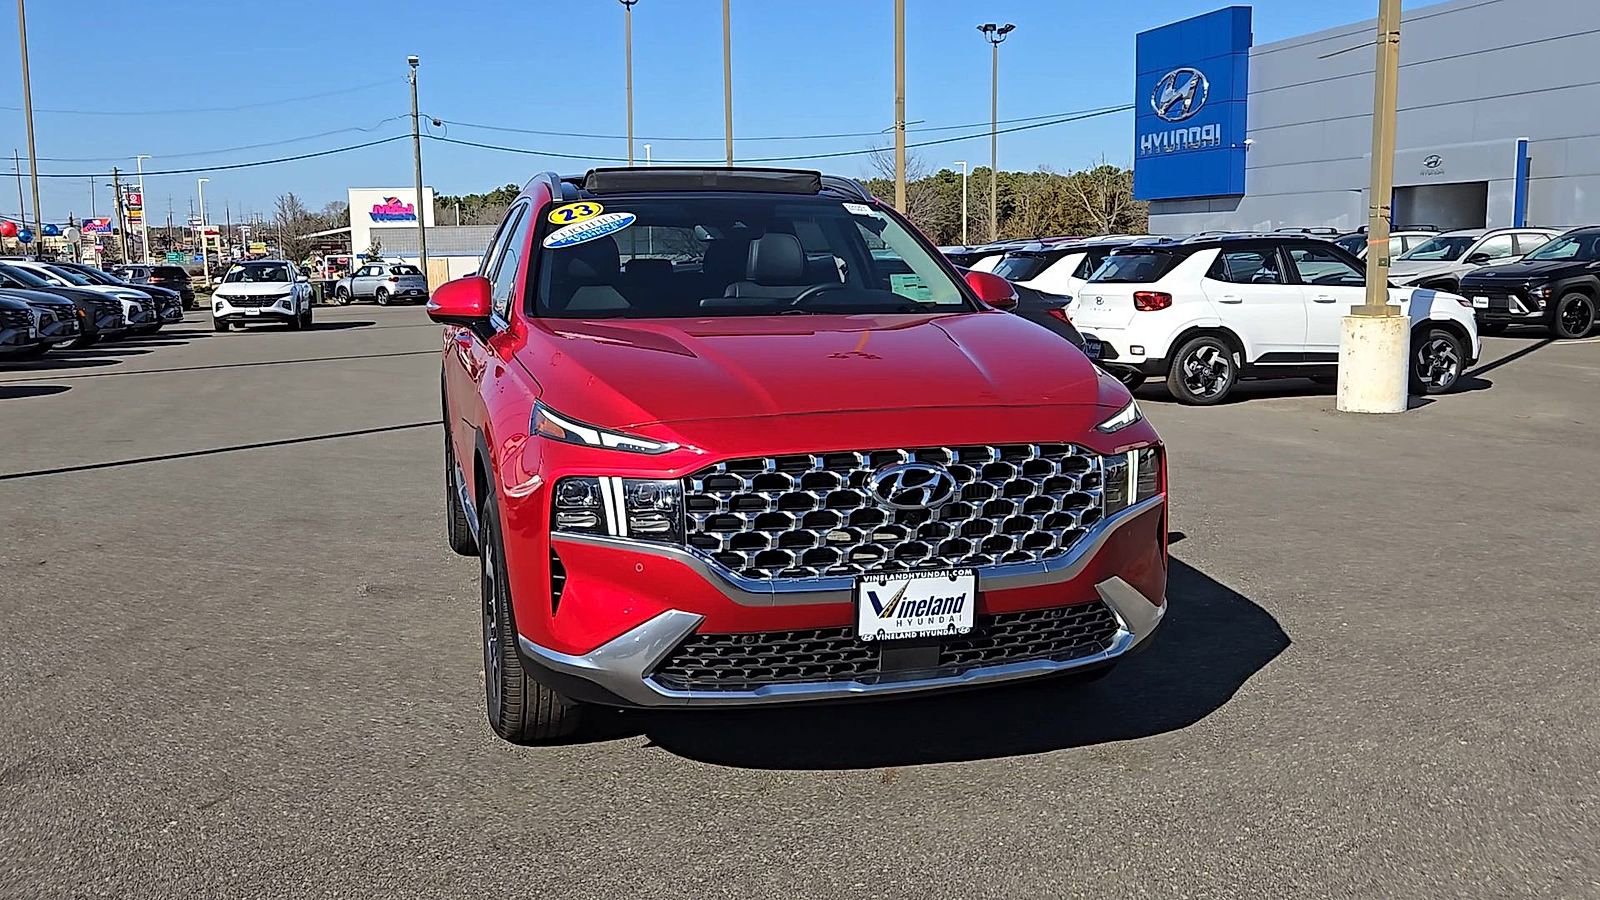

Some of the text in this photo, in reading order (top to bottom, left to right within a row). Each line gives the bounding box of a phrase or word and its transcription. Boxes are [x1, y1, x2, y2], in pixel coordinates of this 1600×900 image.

[1140, 123, 1221, 156] HYUNDAI
[558, 205, 593, 221] 23
[551, 213, 622, 241] CERTIFIED
[863, 569, 972, 582] VINELANDHYUNDAI.COM
[867, 578, 967, 619] Vineland
[896, 615, 962, 627] HYUNDAI
[875, 626, 958, 641] VINELAND HYUNDAI
